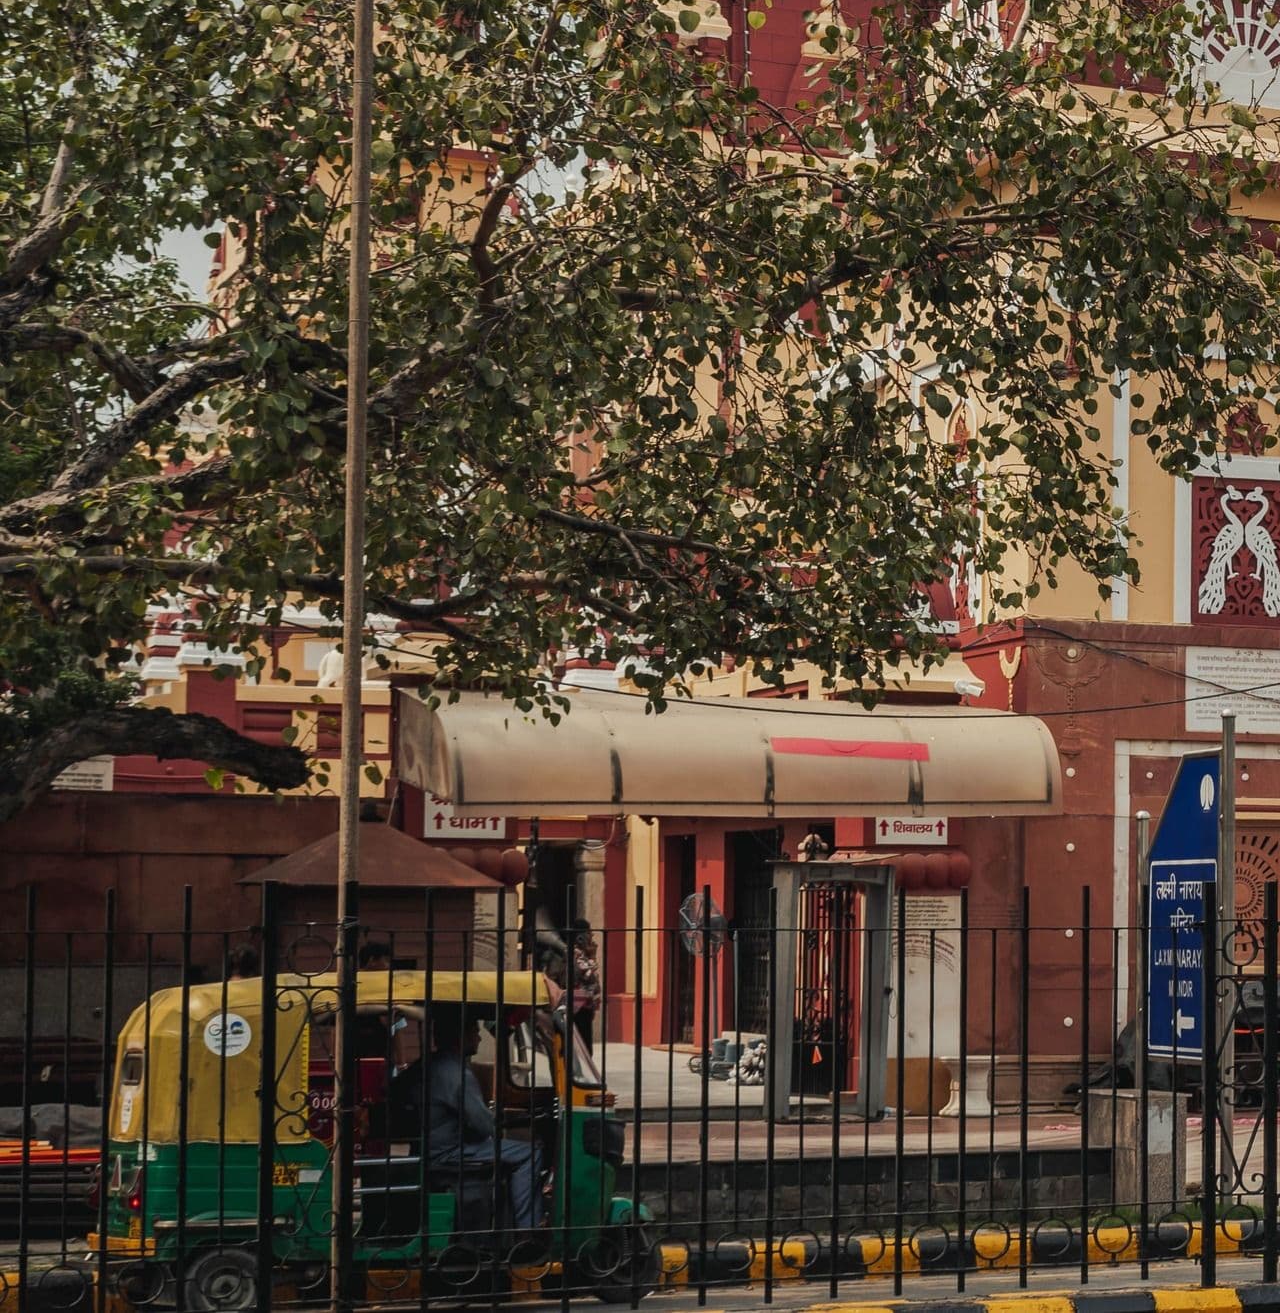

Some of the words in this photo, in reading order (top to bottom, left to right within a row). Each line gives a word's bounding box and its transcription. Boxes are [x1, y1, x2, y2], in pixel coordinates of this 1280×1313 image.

[893, 820, 933, 834] शिवालय
[1156, 873, 1177, 901] लक्ष्मी
[1179, 880, 1203, 900] नाराय
[1154, 948, 1174, 966] LAXM
[1176, 949, 1203, 969] NARAY
[1168, 979, 1194, 998] MNDIR
